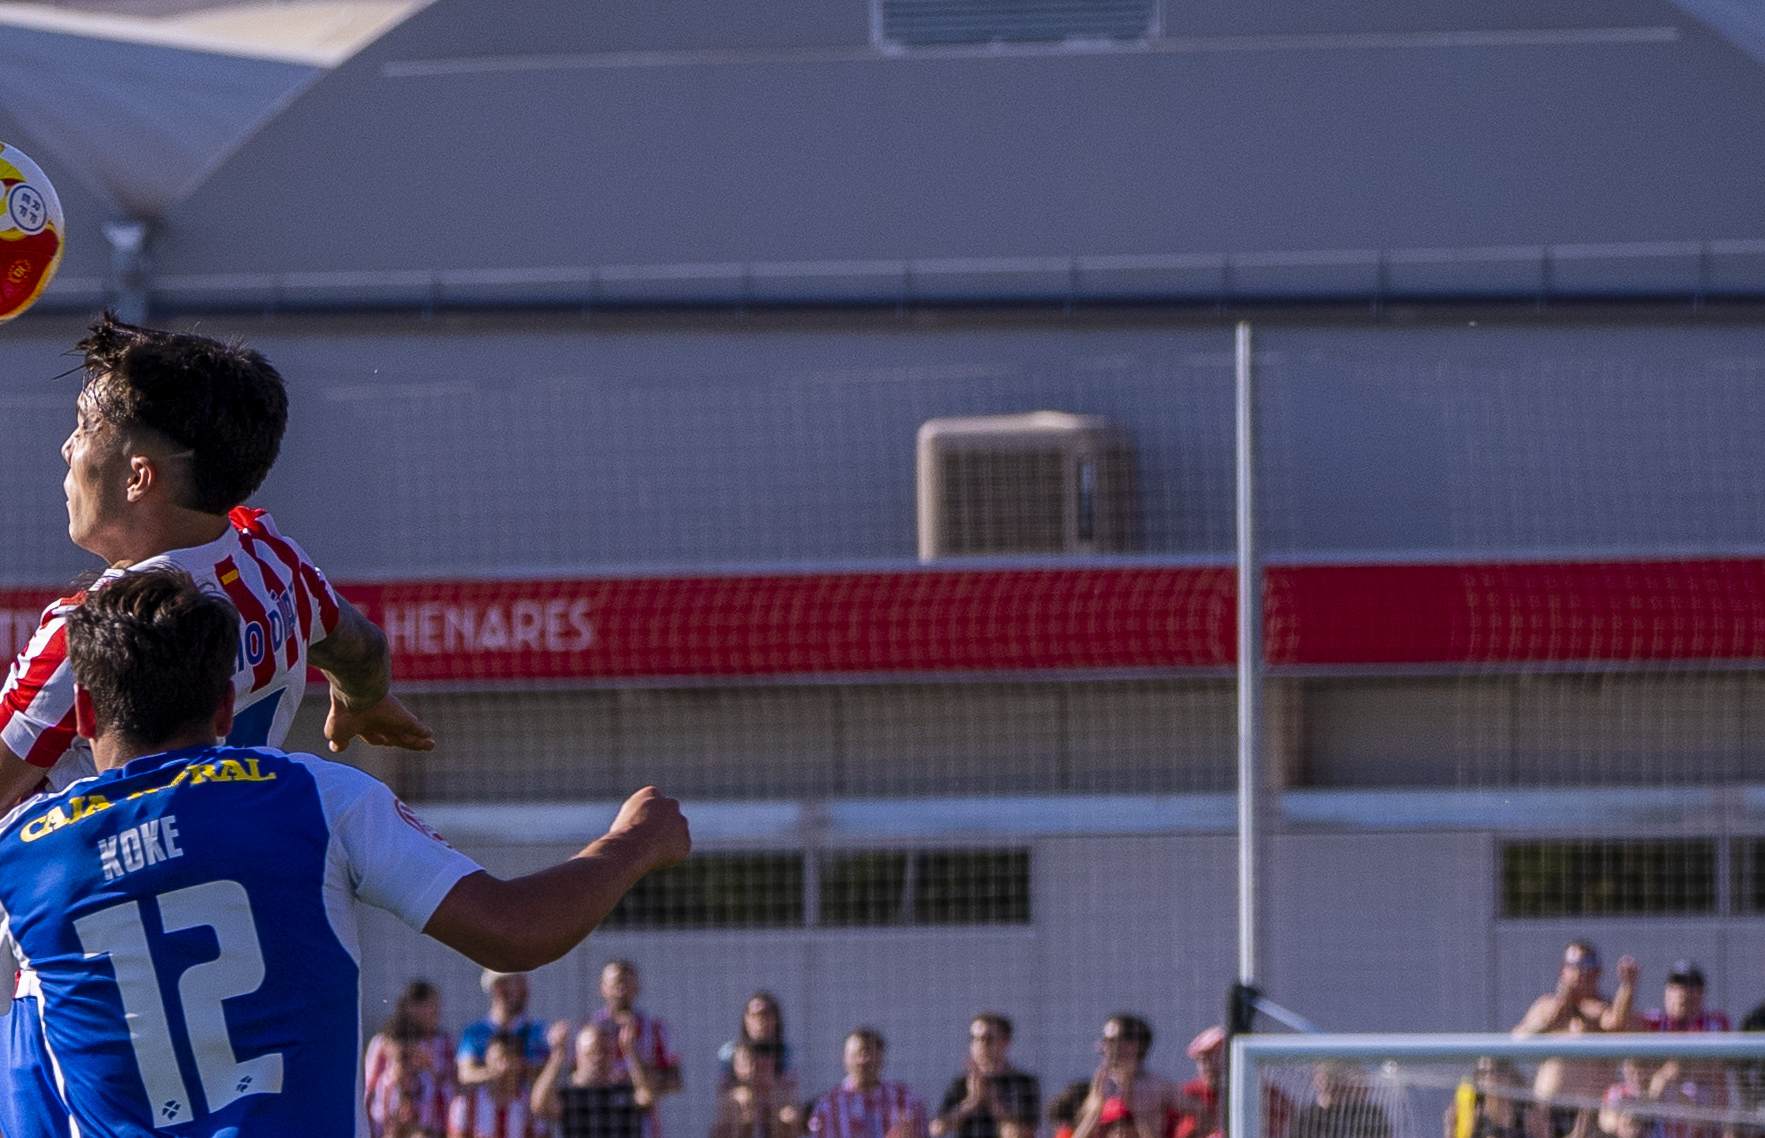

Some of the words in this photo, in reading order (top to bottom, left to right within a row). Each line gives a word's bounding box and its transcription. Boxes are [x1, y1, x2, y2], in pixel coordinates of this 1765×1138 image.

[385, 599, 593, 653] HENARES
[20, 795, 115, 843] CAJA
[98, 814, 184, 881] KOKE
[73, 879, 284, 1129] 12
